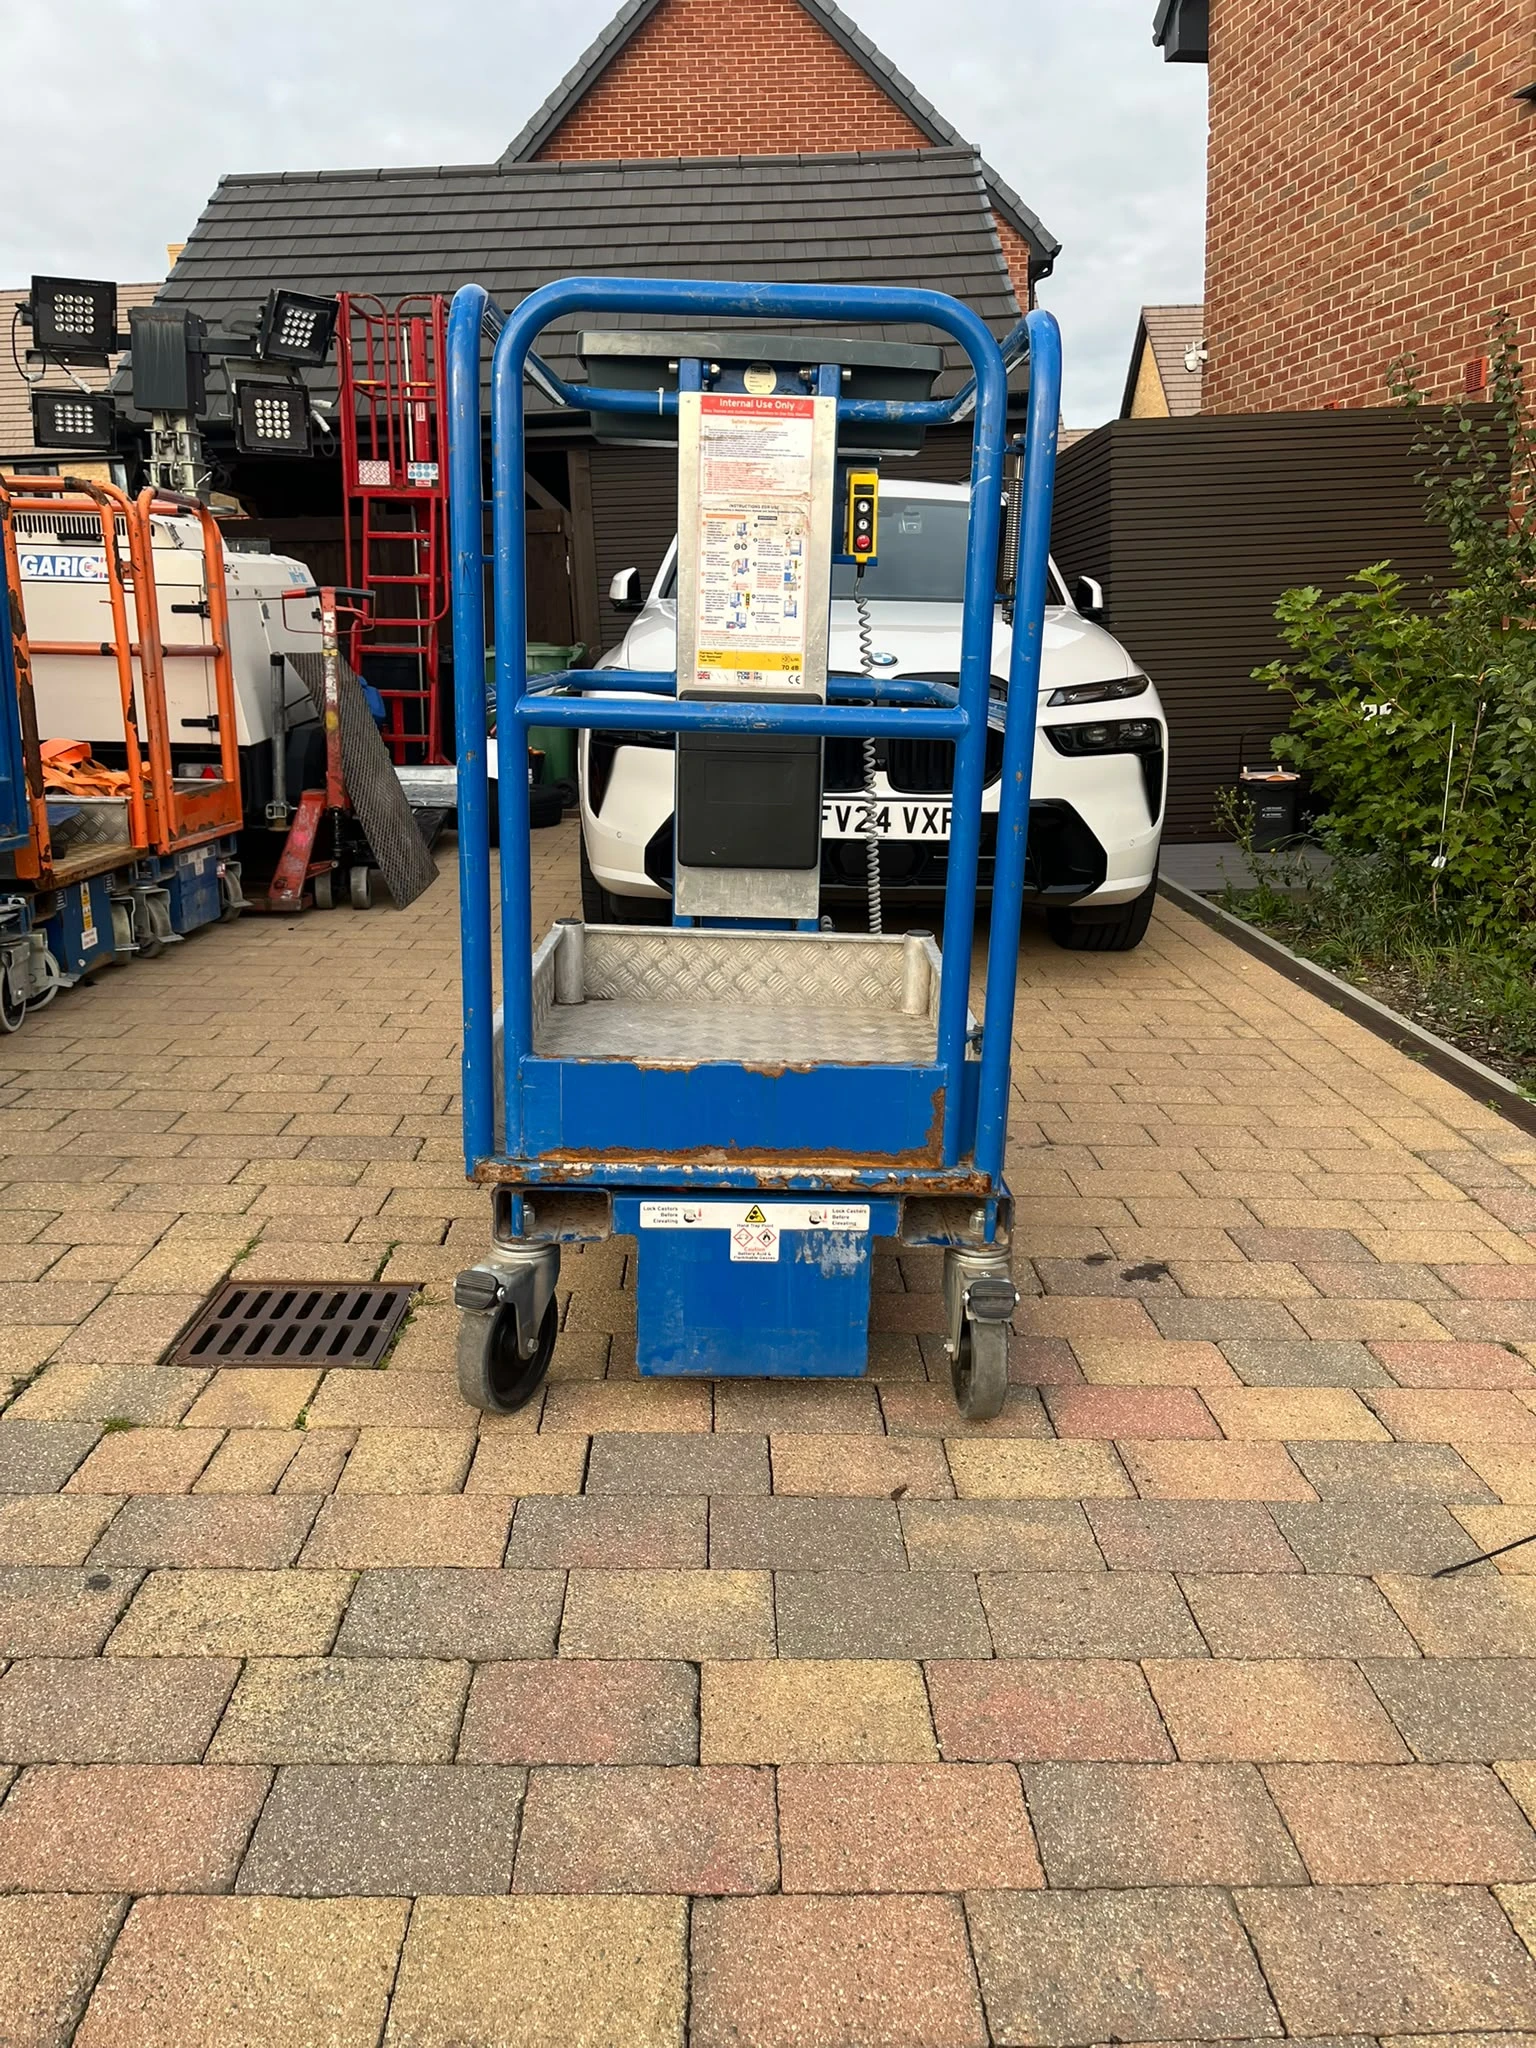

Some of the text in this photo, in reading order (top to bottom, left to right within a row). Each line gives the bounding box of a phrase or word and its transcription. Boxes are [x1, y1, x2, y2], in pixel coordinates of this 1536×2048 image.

[720, 398, 795, 411] Internal Use Only
